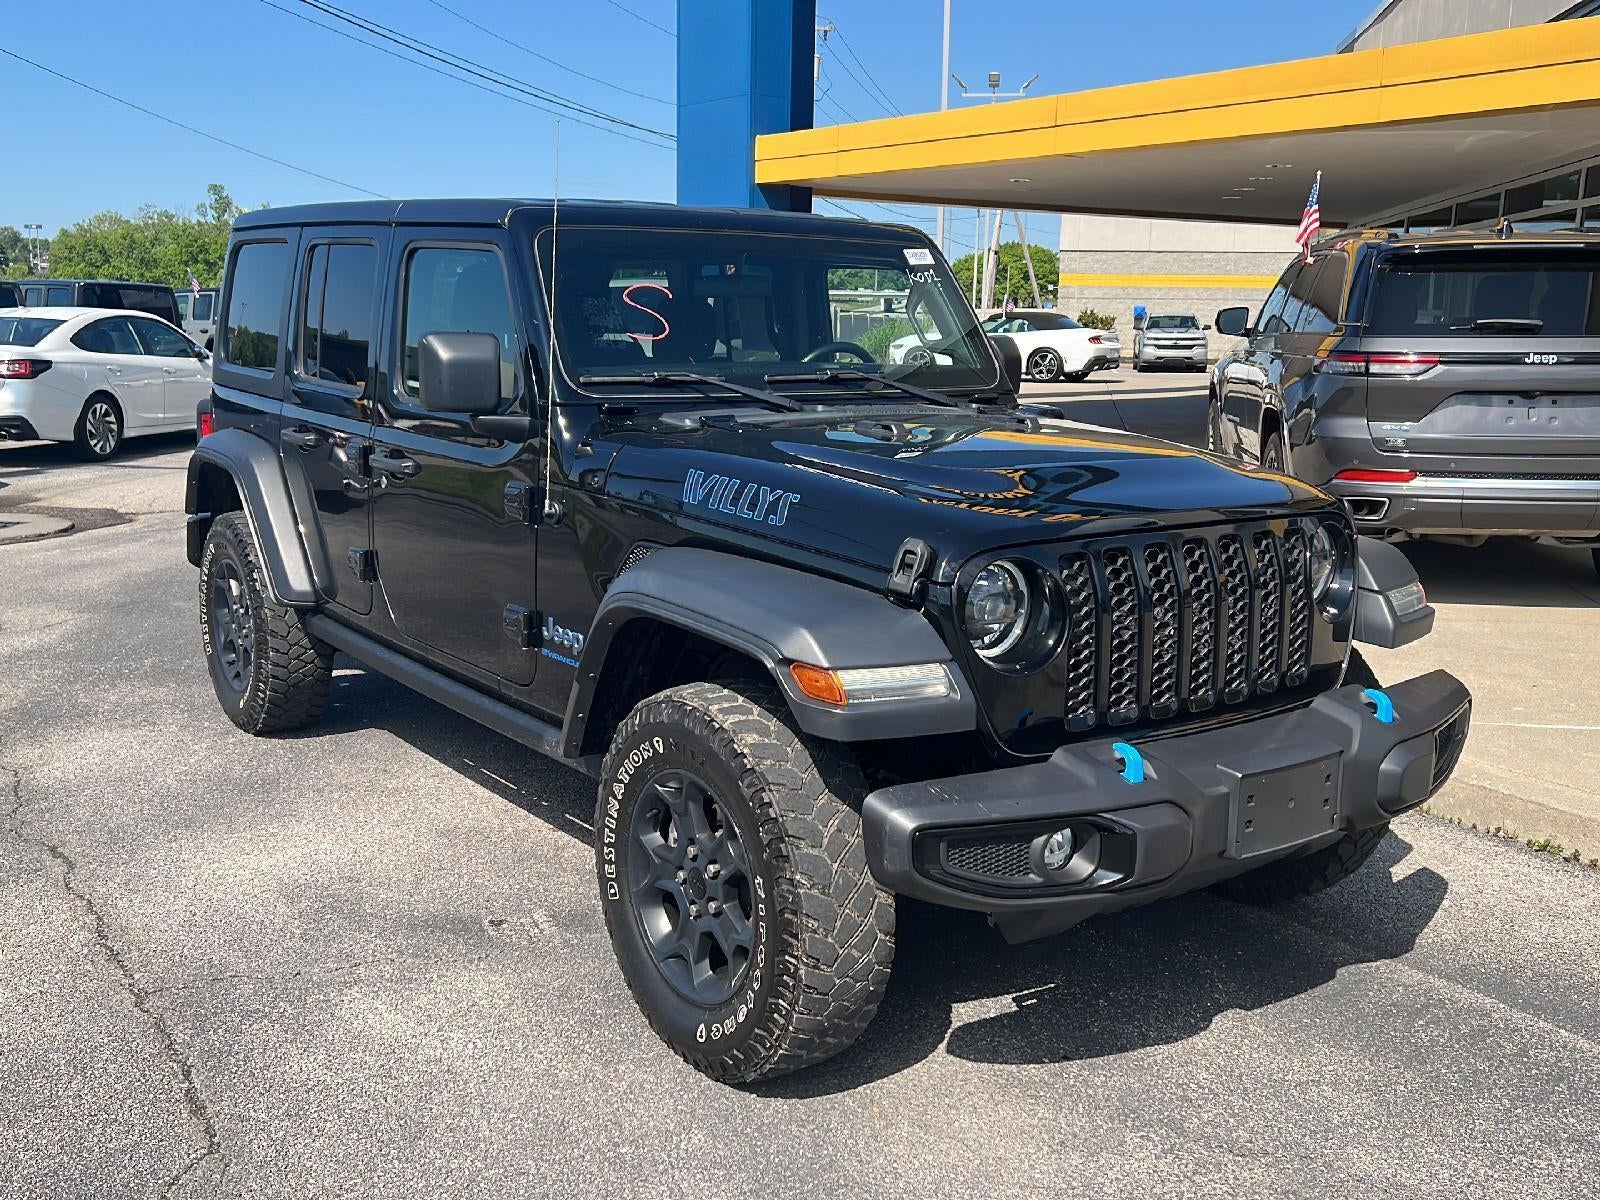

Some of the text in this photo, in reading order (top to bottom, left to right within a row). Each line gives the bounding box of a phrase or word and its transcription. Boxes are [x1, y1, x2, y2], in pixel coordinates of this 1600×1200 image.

[623, 283, 673, 340] S
[1524, 352, 1558, 365] Jeep
[683, 468, 801, 526] WILLYS
[541, 616, 584, 656] Jeep
[603, 741, 654, 900] DESTINATION
